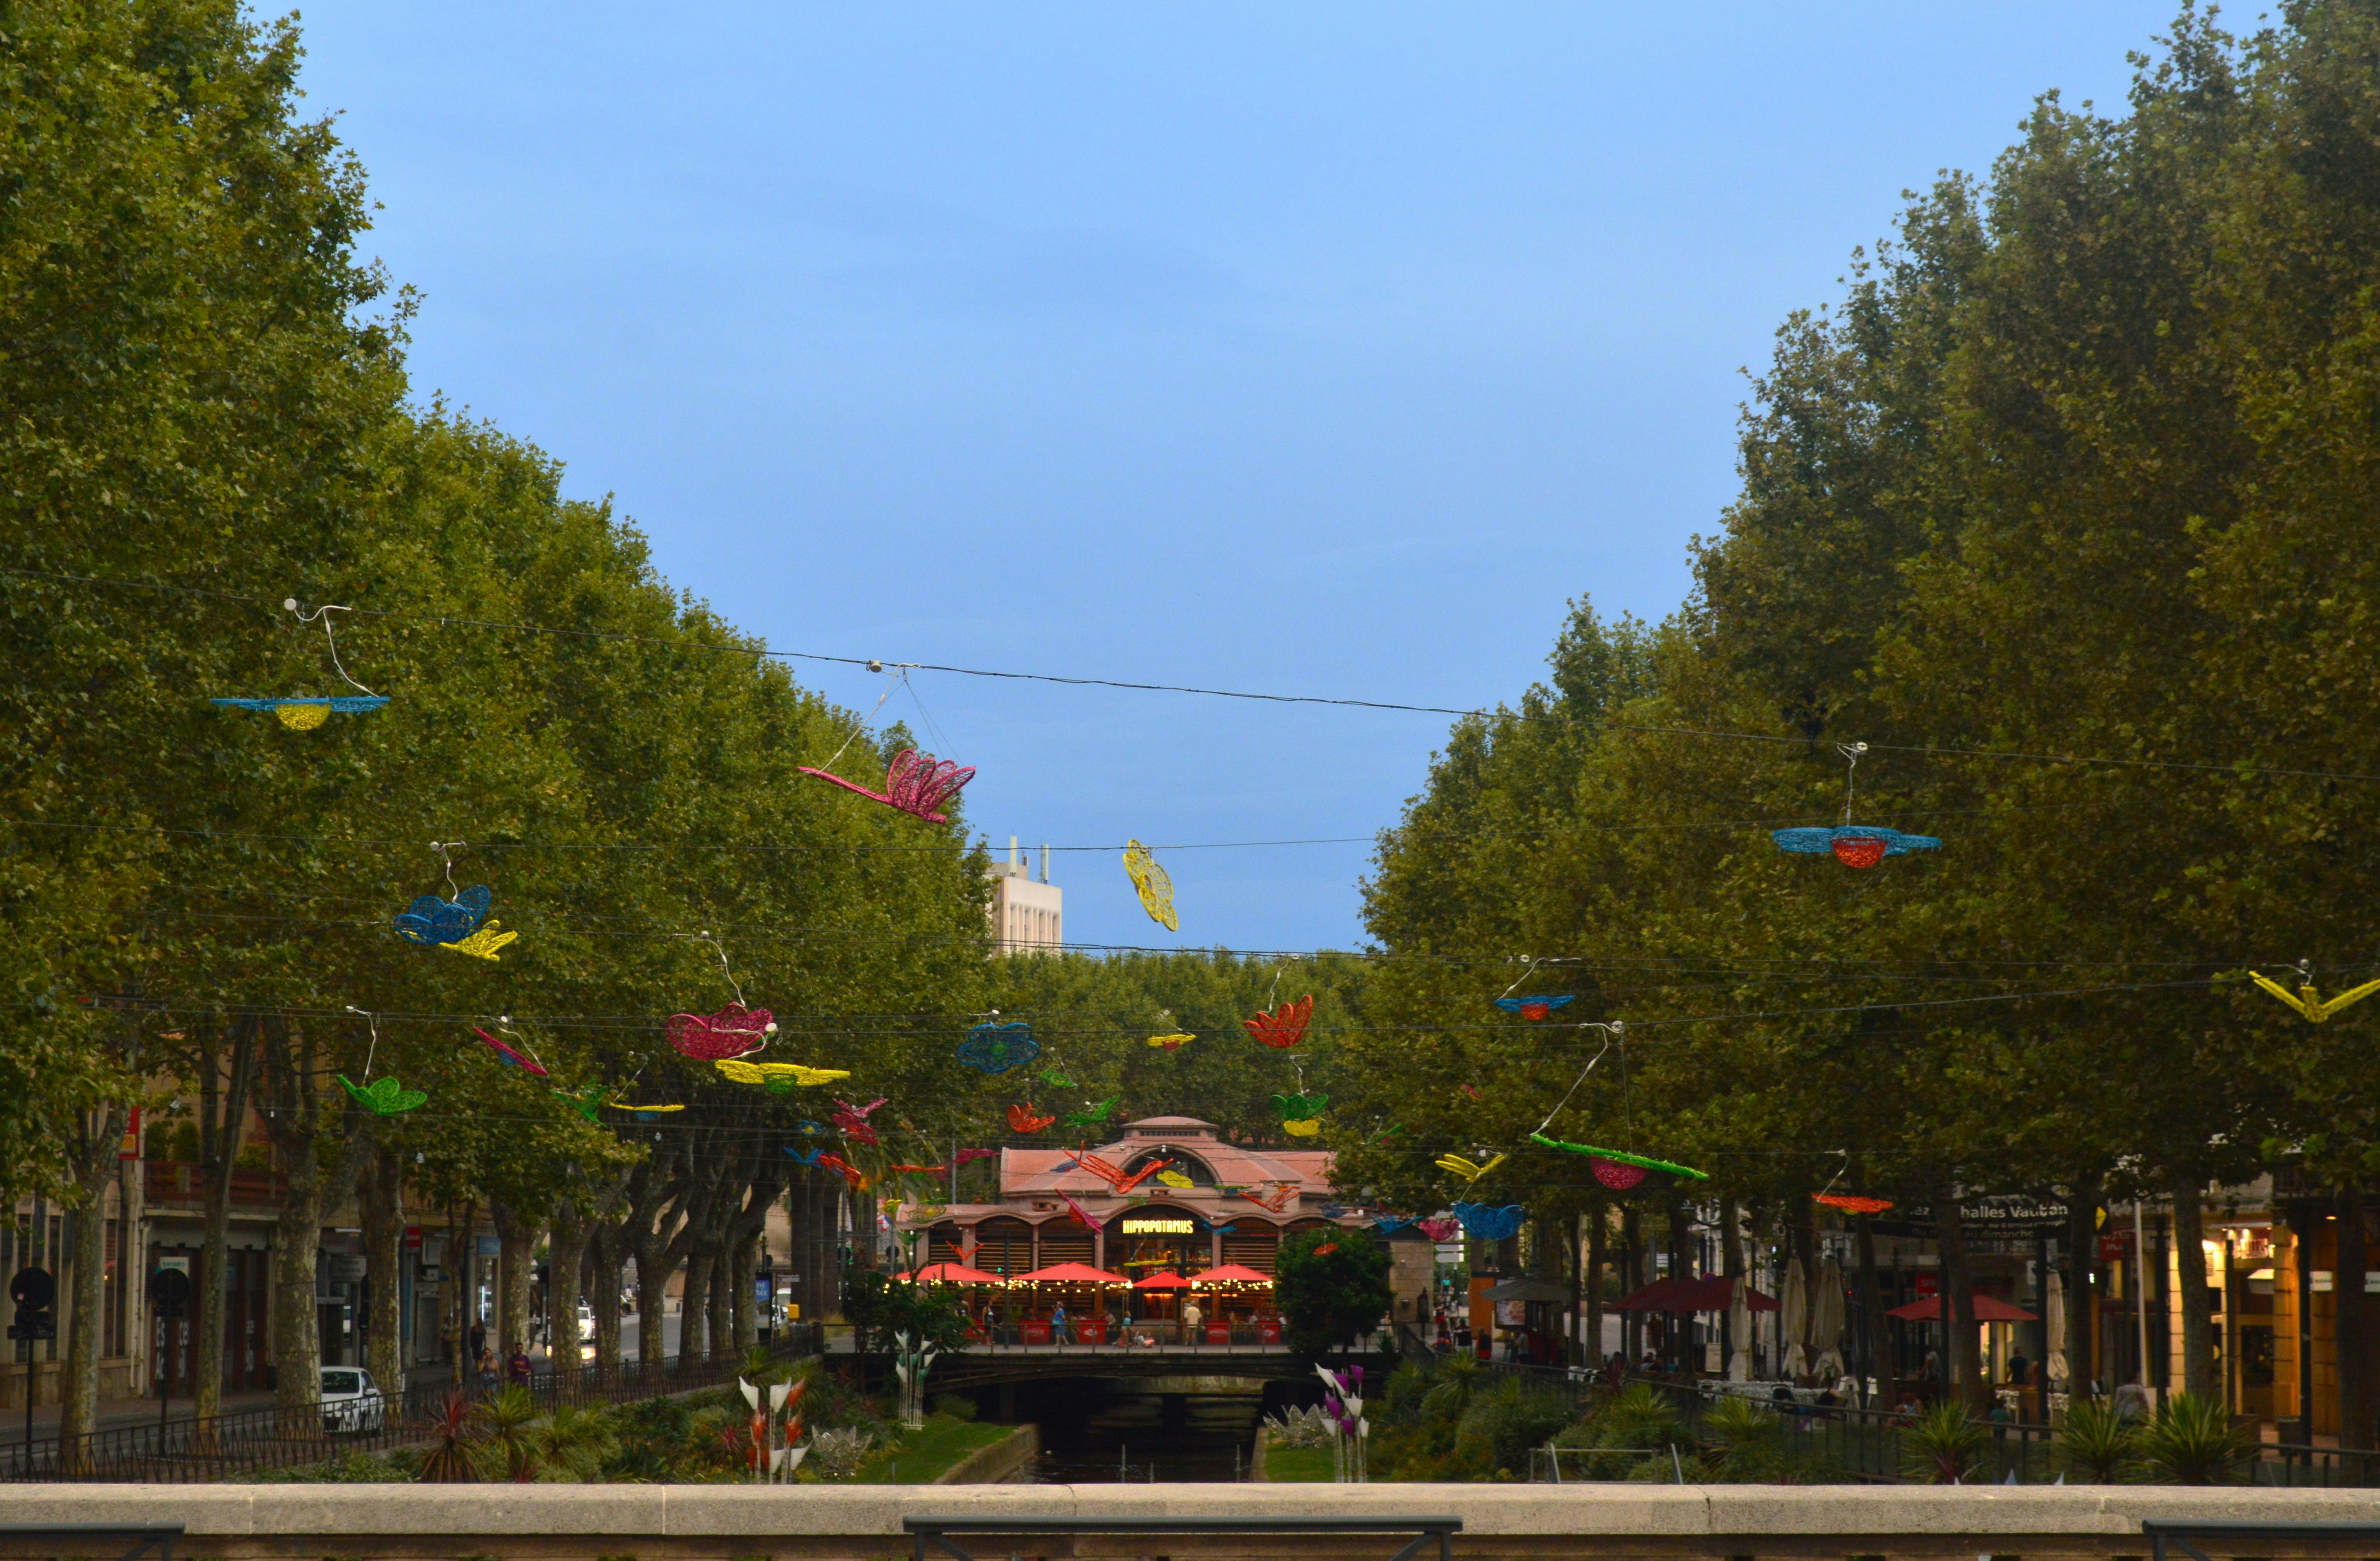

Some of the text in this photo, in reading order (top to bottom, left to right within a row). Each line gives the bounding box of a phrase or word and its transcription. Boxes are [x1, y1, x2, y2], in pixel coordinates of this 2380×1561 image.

[1960, 1204, 2068, 1218] halles Vauban
[1123, 1220, 1194, 1234] HIPPOPOTAMUS
[1981, 1230, 2035, 1238] dimanche
